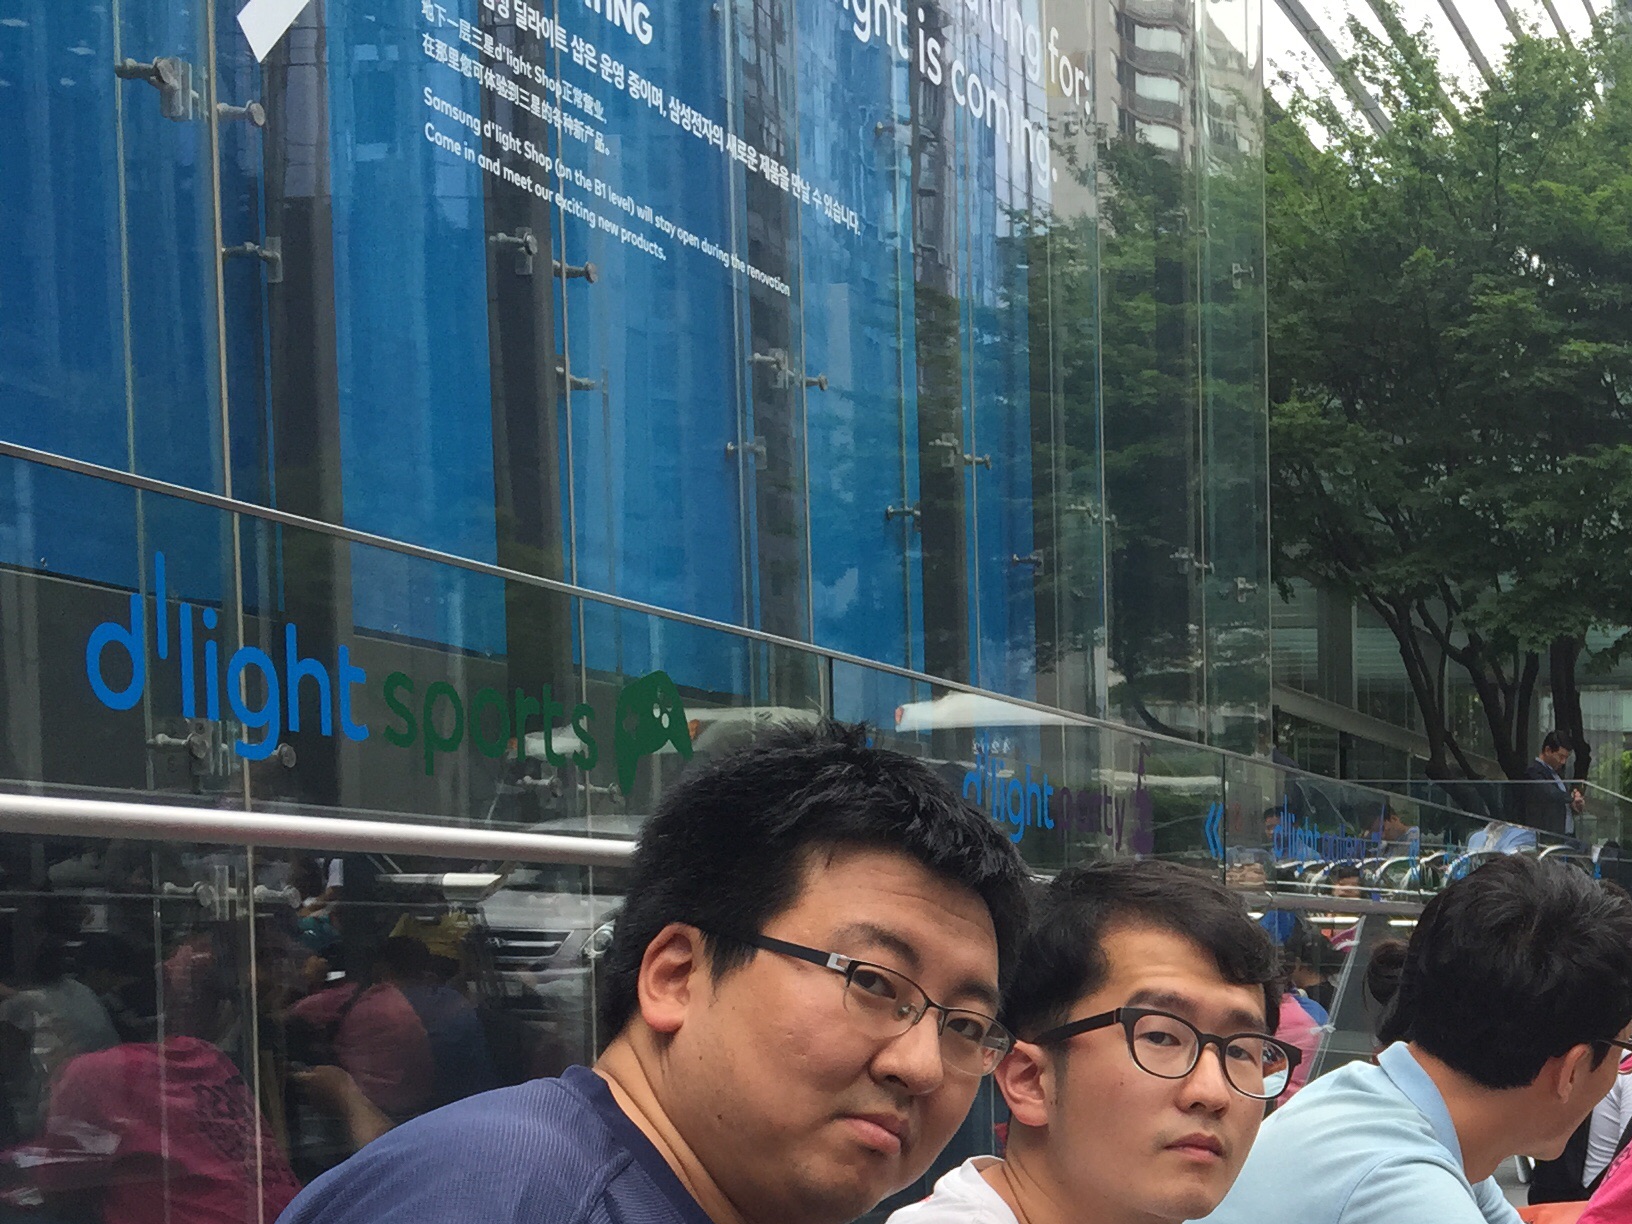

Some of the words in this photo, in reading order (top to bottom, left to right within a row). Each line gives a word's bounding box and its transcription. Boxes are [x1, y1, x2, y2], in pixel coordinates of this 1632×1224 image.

[514, 0, 568, 53] 딜라이트
[571, 34, 598, 73] 샵은
[600, 53, 625, 90] 운영
[628, 70, 667, 118] 중이며,
[668, 95, 724, 152] 삼성전자의
[726, 132, 757, 172] 새로운
[759, 153, 789, 191] 제품을
[812, 186, 823, 210] 수
[824, 193, 861, 236] 있습니다.
[917, 8, 942, 86] is
[951, 59, 1058, 189] coming.
[1048, 27, 1092, 115] for:
[423, 86, 481, 136] Samsung
[483, 120, 522, 154] d'light
[524, 140, 552, 172] Shop
[574, 170, 593, 192] the
[594, 178, 607, 200] B1
[608, 185, 635, 217] level)
[636, 204, 654, 224] will
[655, 214, 676, 239] stay
[677, 227, 700, 250] open
[701, 236, 730, 268] during
[731, 251, 746, 273] the
[746, 263, 790, 297] renovation
[424, 121, 461, 155] Come
[463, 141, 476, 162] in
[478, 153, 500, 176] and
[503, 166, 533, 193] meet
[535, 183, 554, 203] our
[555, 191, 596, 228] exciting
[597, 212, 619, 238] new
[620, 226, 667, 261] products.
[86, 551, 369, 762] d'light
[383, 671, 598, 776] sports
